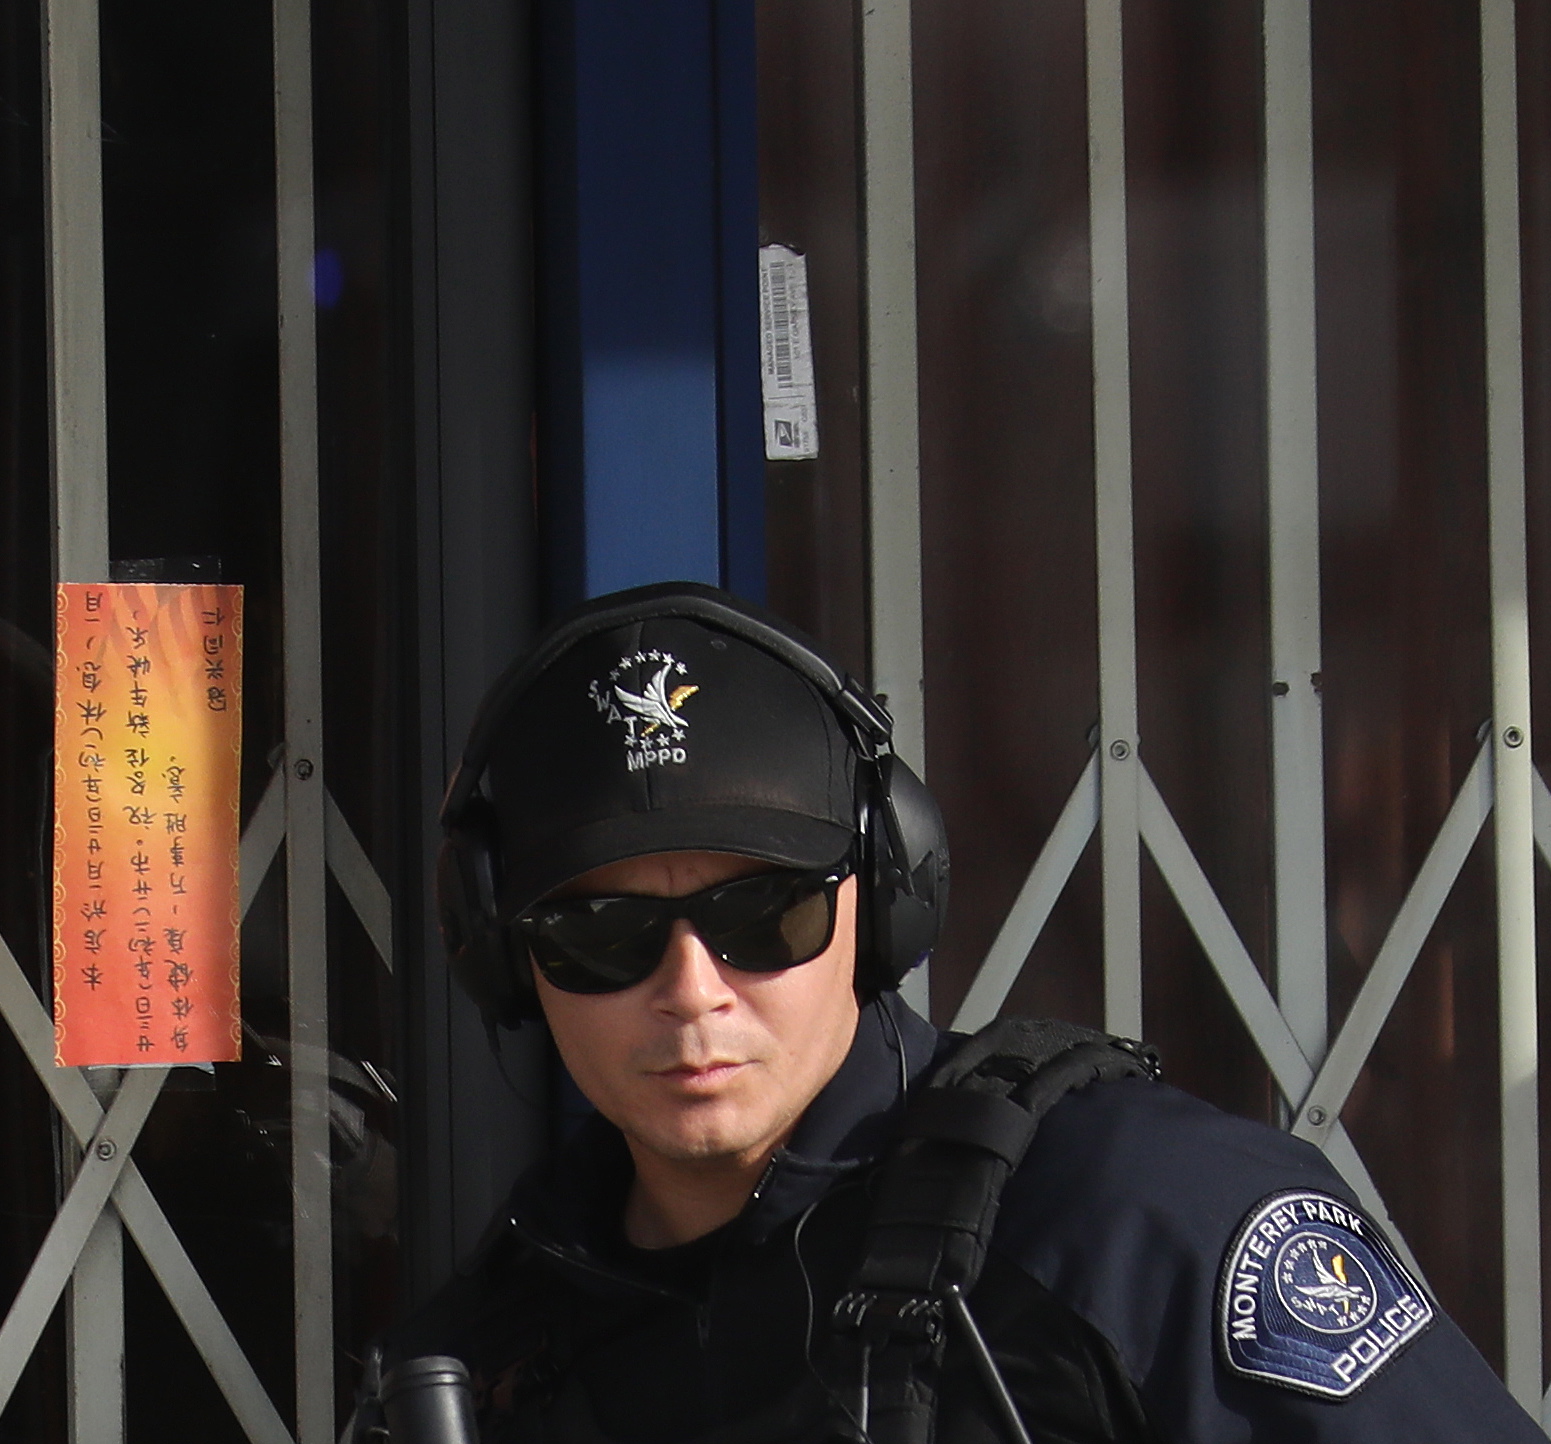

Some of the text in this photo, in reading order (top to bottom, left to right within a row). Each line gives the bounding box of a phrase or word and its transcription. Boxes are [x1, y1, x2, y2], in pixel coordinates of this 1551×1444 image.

[587, 679, 639, 740] SWAT
[1231, 1200, 1364, 1341] MONTEREY PARK
[1332, 1294, 1425, 1383] POLICE
